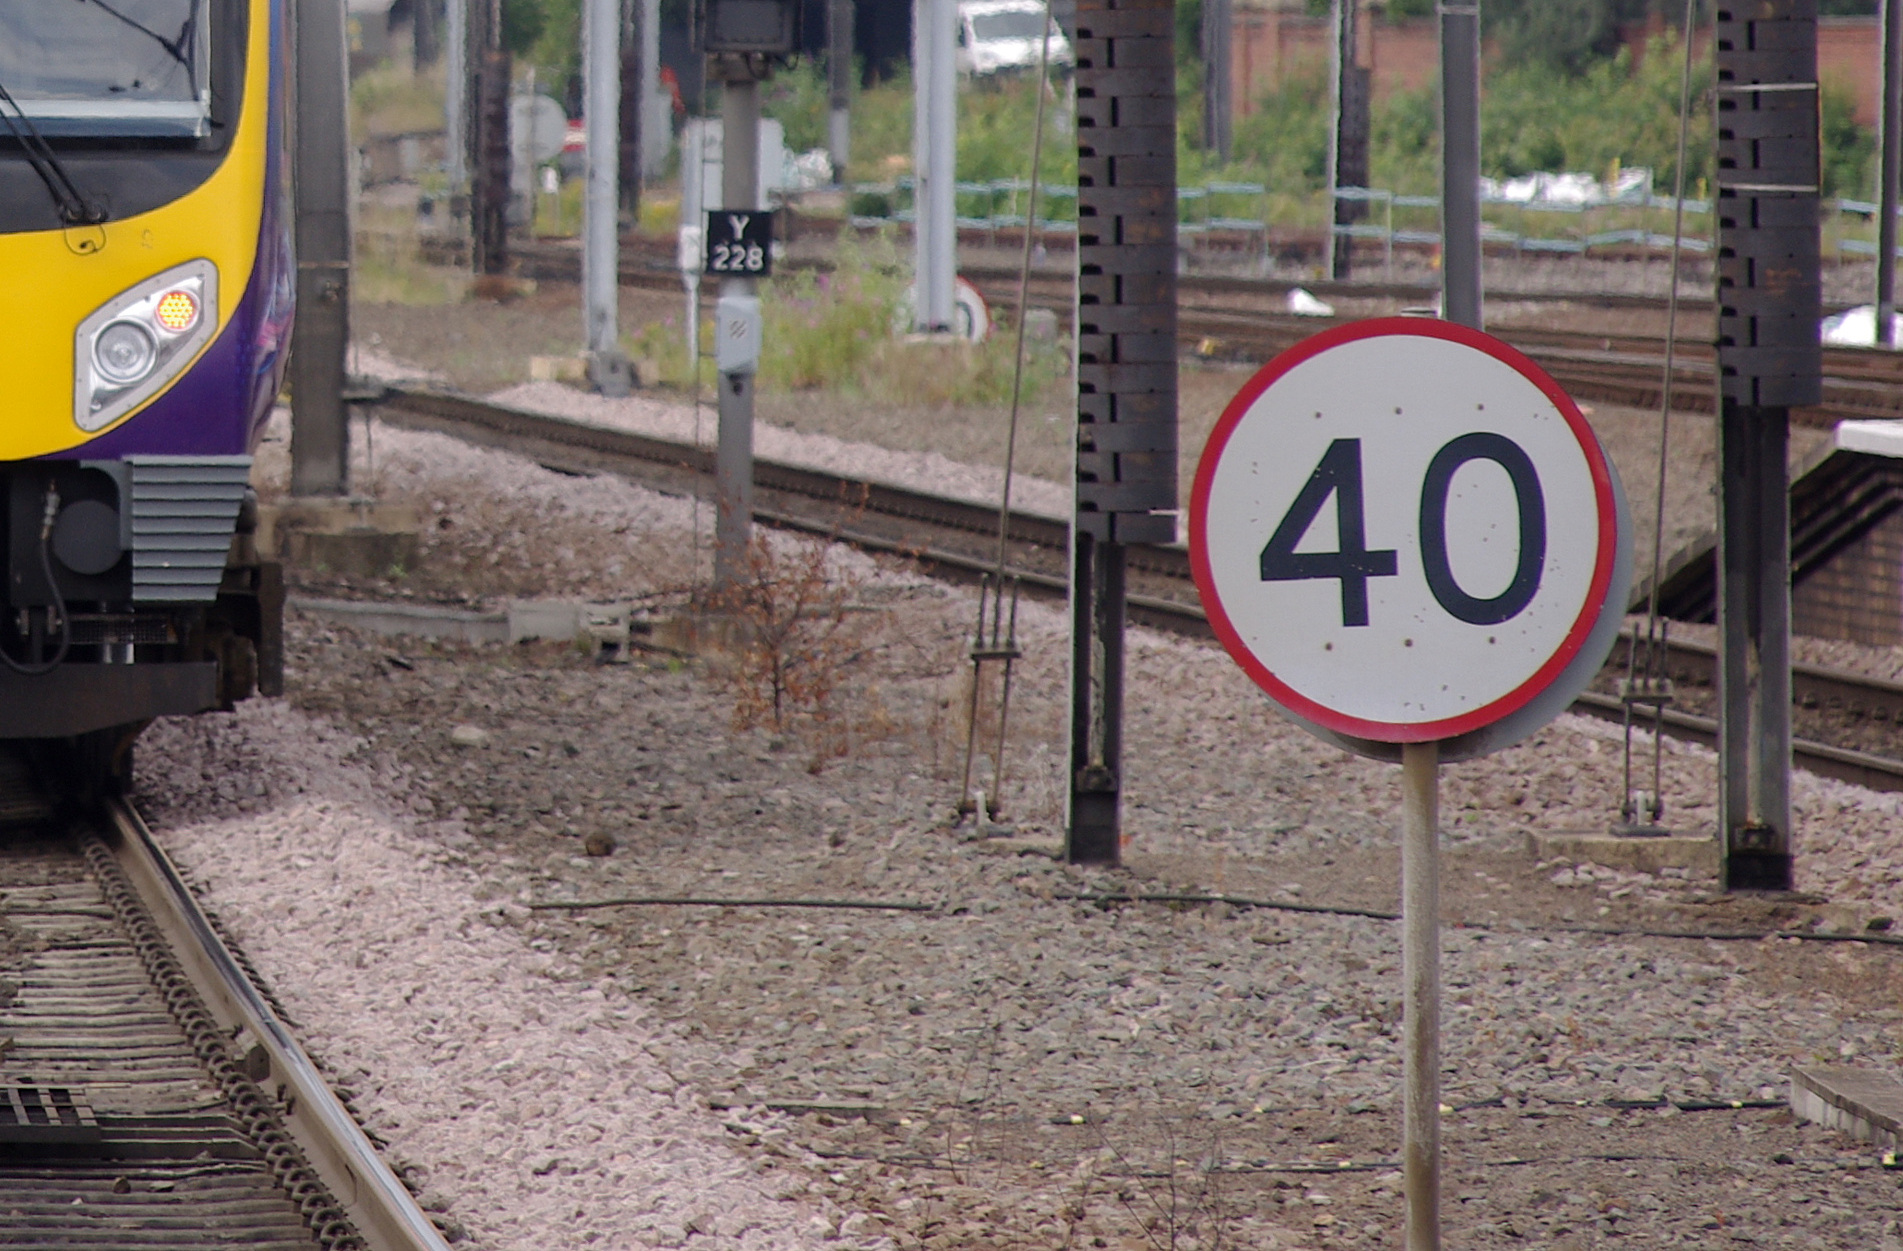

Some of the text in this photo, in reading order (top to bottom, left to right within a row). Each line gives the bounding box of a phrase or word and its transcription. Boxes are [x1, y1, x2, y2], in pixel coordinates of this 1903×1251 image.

[729, 215, 749, 240] Y
[714, 245, 764, 271] 228
[1259, 432, 1547, 627] 40
